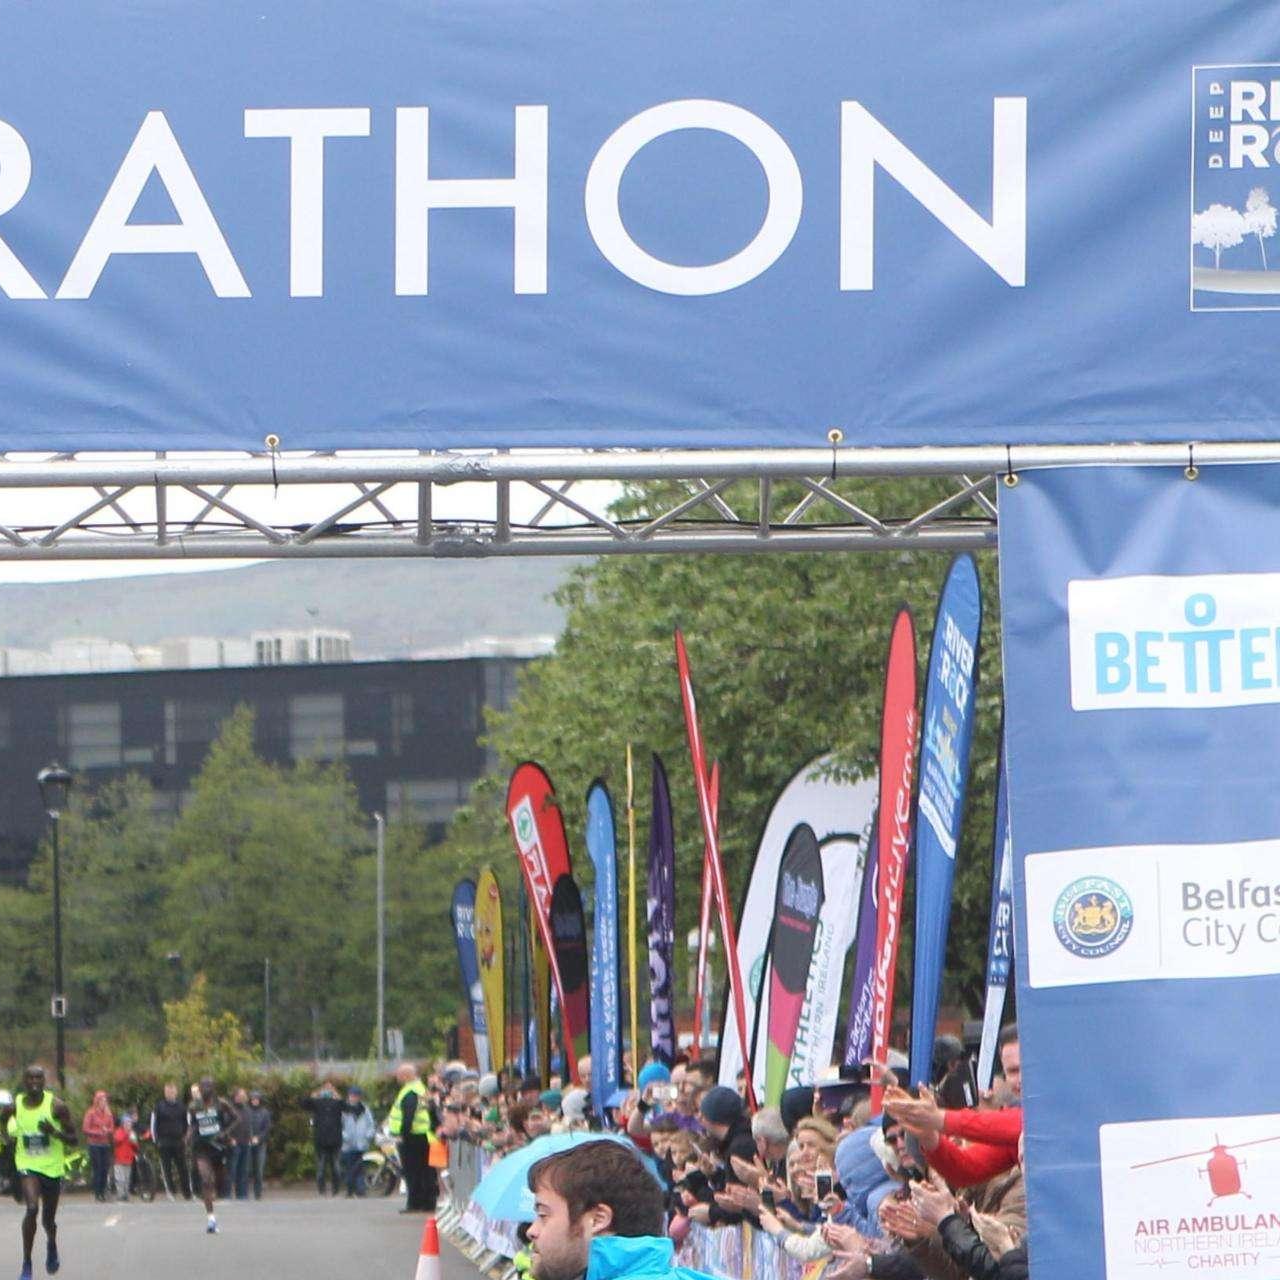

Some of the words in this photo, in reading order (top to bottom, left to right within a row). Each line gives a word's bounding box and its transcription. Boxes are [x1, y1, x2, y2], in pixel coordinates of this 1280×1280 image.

[1207, 82, 1224, 169] DEEP
[1229, 124, 1280, 169] R
[1095, 627, 1280, 695] BETTE
[1182, 916, 1247, 955] City
[1257, 913, 1280, 943] C
[1134, 1235, 1233, 1255] NORTHERN
[1135, 1219, 1171, 1237] AIR
[1187, 1252, 1261, 1270] CHARITY
